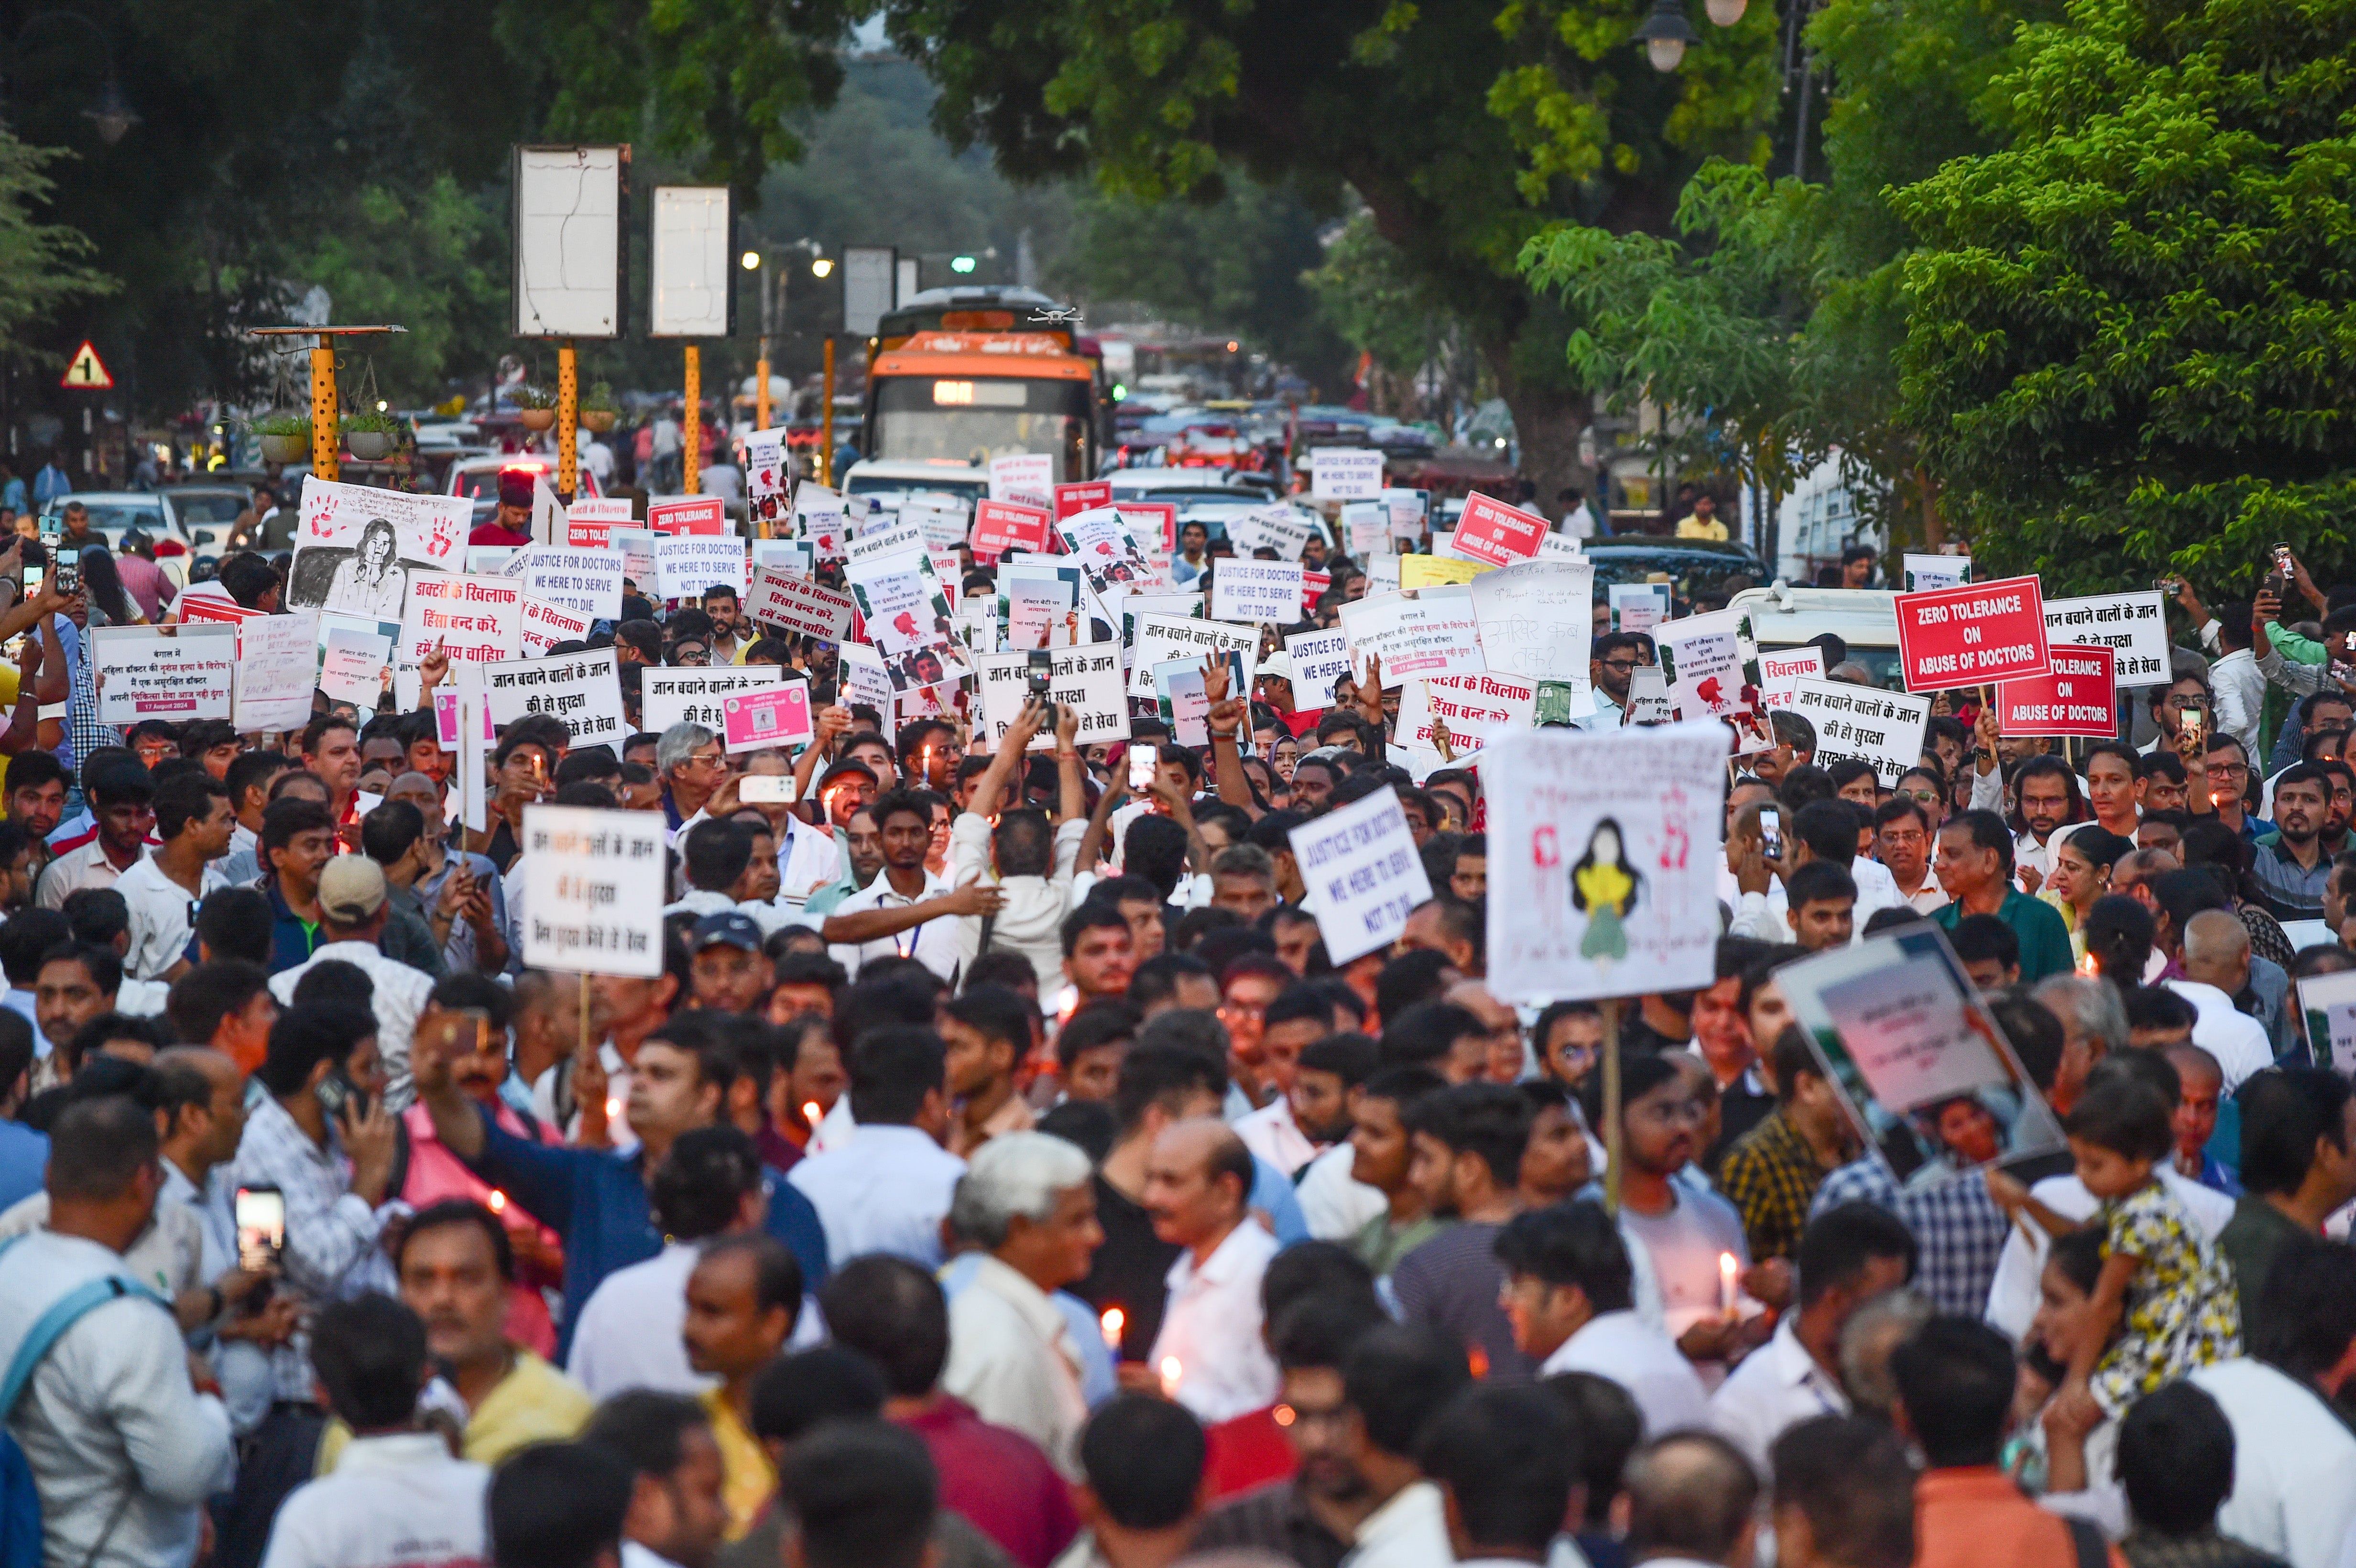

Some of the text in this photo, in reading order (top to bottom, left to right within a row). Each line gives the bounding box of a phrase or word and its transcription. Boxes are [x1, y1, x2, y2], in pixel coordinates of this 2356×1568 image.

[1316, 457, 1380, 466] JUSTICE FOR DOCTORS
[1331, 470, 1345, 479] HERE
[658, 508, 713, 525] ZERO TOLERANCE
[1475, 504, 1536, 537] ZERO TOLERANCE
[570, 529, 588, 540] ZERO
[680, 526, 689, 535] ON
[1493, 527, 1505, 540] ON
[659, 544, 742, 556] JUSTICE FOR DOCTORS
[531, 554, 561, 568] JUSTICE
[564, 555, 579, 569] FOR
[582, 557, 621, 572] DOCTORS
[666, 563, 676, 574] WE
[679, 562, 698, 573] HERE
[701, 562, 710, 573] TO
[713, 562, 736, 574] SERVE
[535, 575, 612, 592] WE HERE TO SERVE
[1218, 566, 1300, 582] JUSTICE FOR DOCTORS
[1922, 573, 1931, 582] दुर्गा
[1932, 573, 1944, 582] जैसा
[416, 580, 517, 604] डाक्टरों के खिलाफ
[681, 580, 708, 591] NOT TO
[764, 574, 852, 609] डाक्टरों के खिलाफ
[1224, 585, 1292, 600] WE HERE TO SERVE
[1931, 581, 1942, 590] पूजो
[769, 591, 835, 623] हिंसा बन्द करे,
[1238, 603, 1277, 617] NOT TO DIE
[1917, 594, 2022, 625] ZERO TOLERANCE
[2065, 603, 2158, 626] बचाने वालों के जान
[423, 609, 502, 637] हिंसा बन्द करे,
[528, 603, 586, 634] के खिलाफ
[759, 607, 833, 638] हमें न्याय चाहिए
[1400, 613, 1418, 621] बंगाल
[1145, 624, 1253, 653] जान बचाने वालों के जान
[1479, 613, 1580, 648] आखिर कब
[1963, 626, 1981, 644] ON
[342, 657, 367, 665] अत्याचार
[1698, 647, 1712, 656] पूजो
[1919, 643, 2035, 676] ABUSE OF DOCTORS
[103, 661, 226, 675] महिला डॉक्टर की नृशंस हत्या के विरोध
[492, 661, 611, 687] जान बचाने वालों के जान
[1303, 661, 1342, 680] WE HERE
[1765, 659, 1817, 678] खिलाफ
[2051, 658, 2102, 677] TOLERANCE
[2128, 656, 2161, 675] हो सेवा
[139, 679, 151, 688] एक
[153, 677, 184, 689] असुरक्षित
[186, 676, 207, 685] डॉक्टर
[652, 676, 735, 695] जान बचाने वालों
[1464, 675, 1476, 690] के
[1480, 676, 1532, 701] खिलाफ
[2057, 681, 2073, 698] ON
[525, 693, 585, 715] की हो सुरक्षा
[683, 704, 711, 722] की हो
[1800, 691, 1921, 724] जान बचाने वालों के जान
[2012, 704, 2107, 723] ABUSE OF DOCTORS
[582, 715, 616, 734] हो सेवा
[1081, 711, 1117, 730] हो सेवा
[1823, 720, 1886, 747] की हो सुरक्षा
